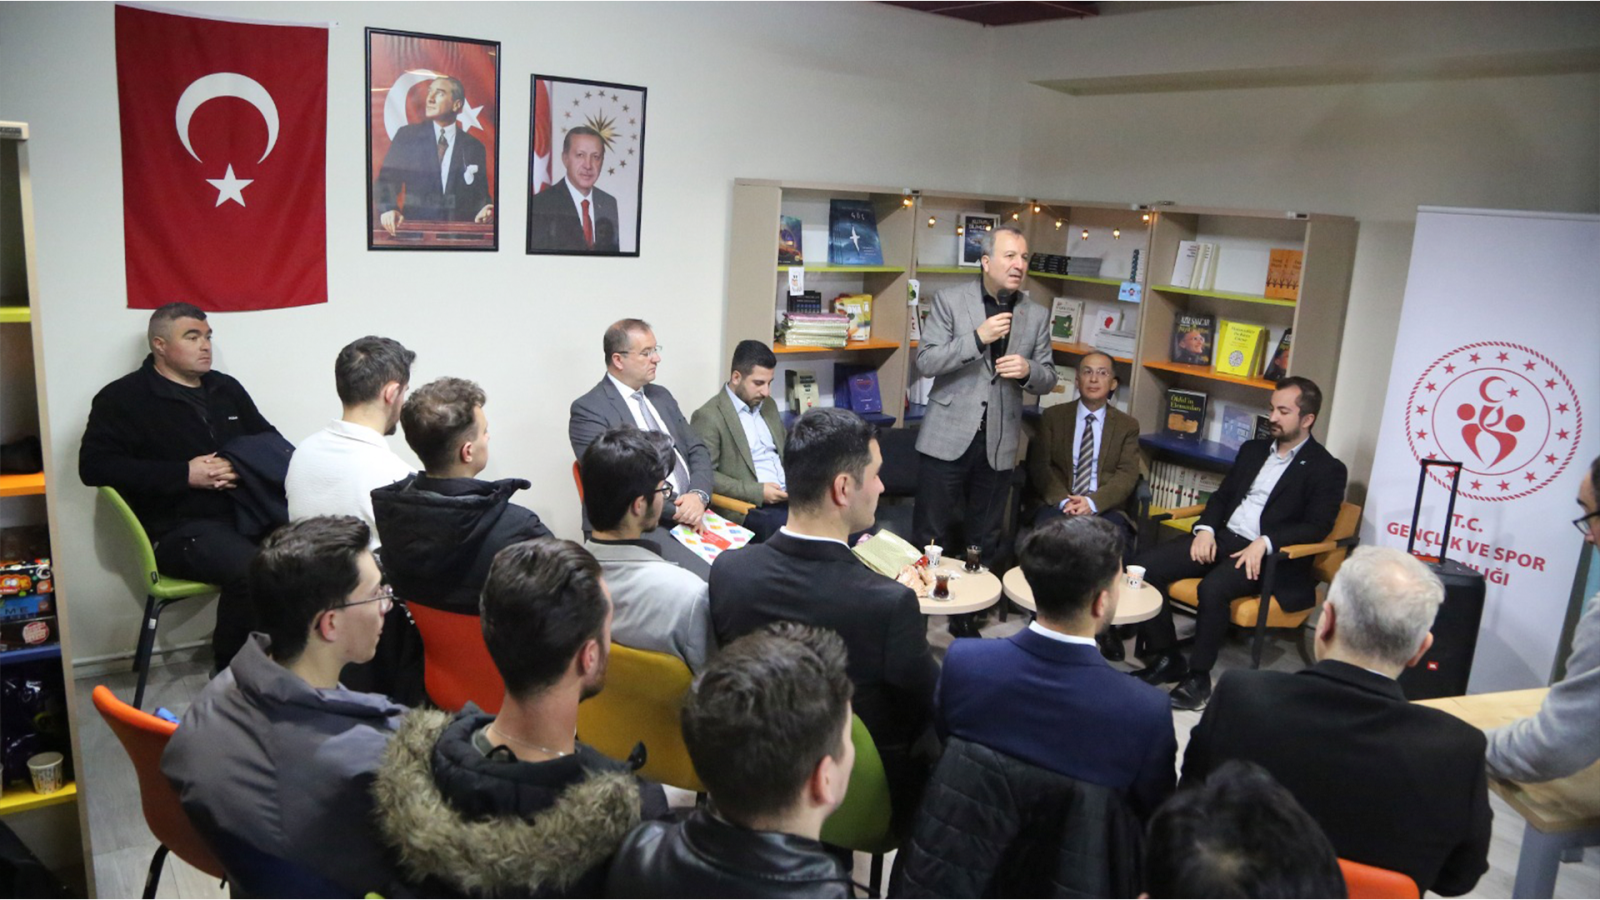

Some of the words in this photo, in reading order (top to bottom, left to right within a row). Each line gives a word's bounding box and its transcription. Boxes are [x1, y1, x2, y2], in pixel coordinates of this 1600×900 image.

[1452, 514, 1483, 533] T.C.
[1387, 522, 1463, 551] GENÇLK
[1467, 540, 1491, 558] VE
[1494, 547, 1546, 571] SPOR
